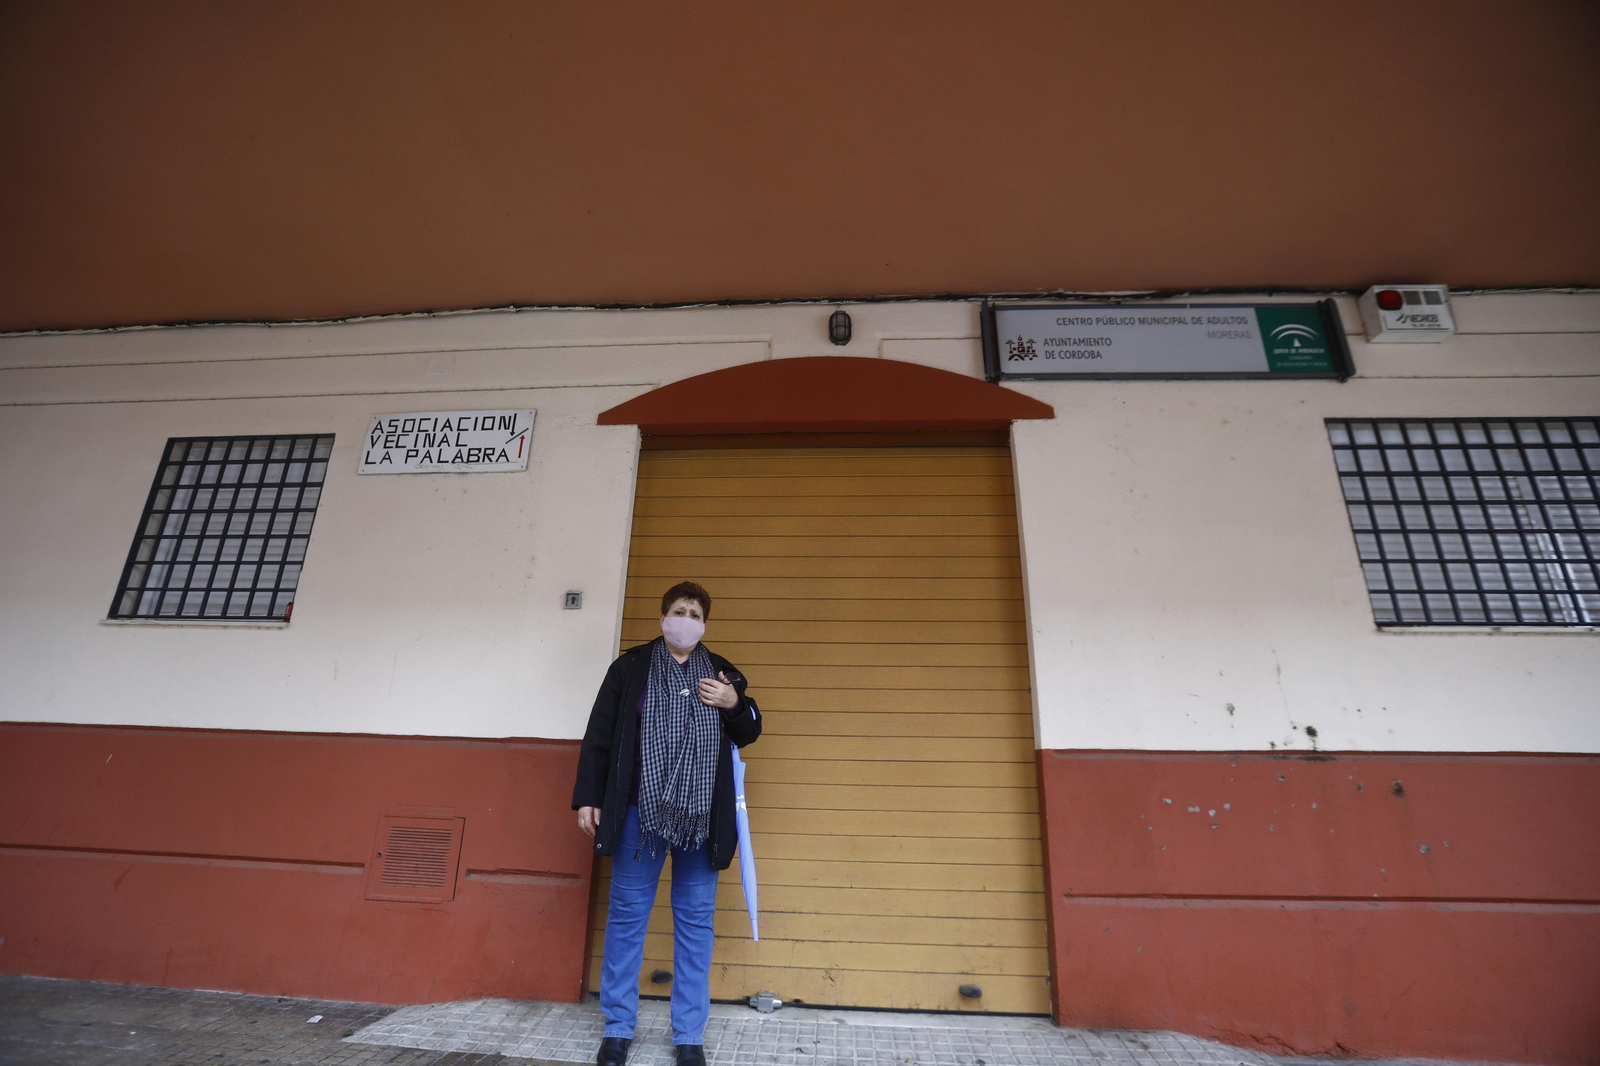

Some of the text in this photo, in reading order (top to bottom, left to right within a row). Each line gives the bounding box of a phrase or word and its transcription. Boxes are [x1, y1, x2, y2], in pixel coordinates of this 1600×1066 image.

[1056, 315, 1249, 326] CENTRO PÚBLICO MUNICIPAL DE ADULTOS
[1207, 330, 1253, 339] MORERAS
[1043, 337, 1112, 347] AYUNTAMIENTO
[1045, 350, 1103, 360] DE CORDOBA
[371, 415, 512, 435] ASOCIACION
[370, 432, 468, 449] VECINAL
[364, 447, 510, 465] LA PALABRA
